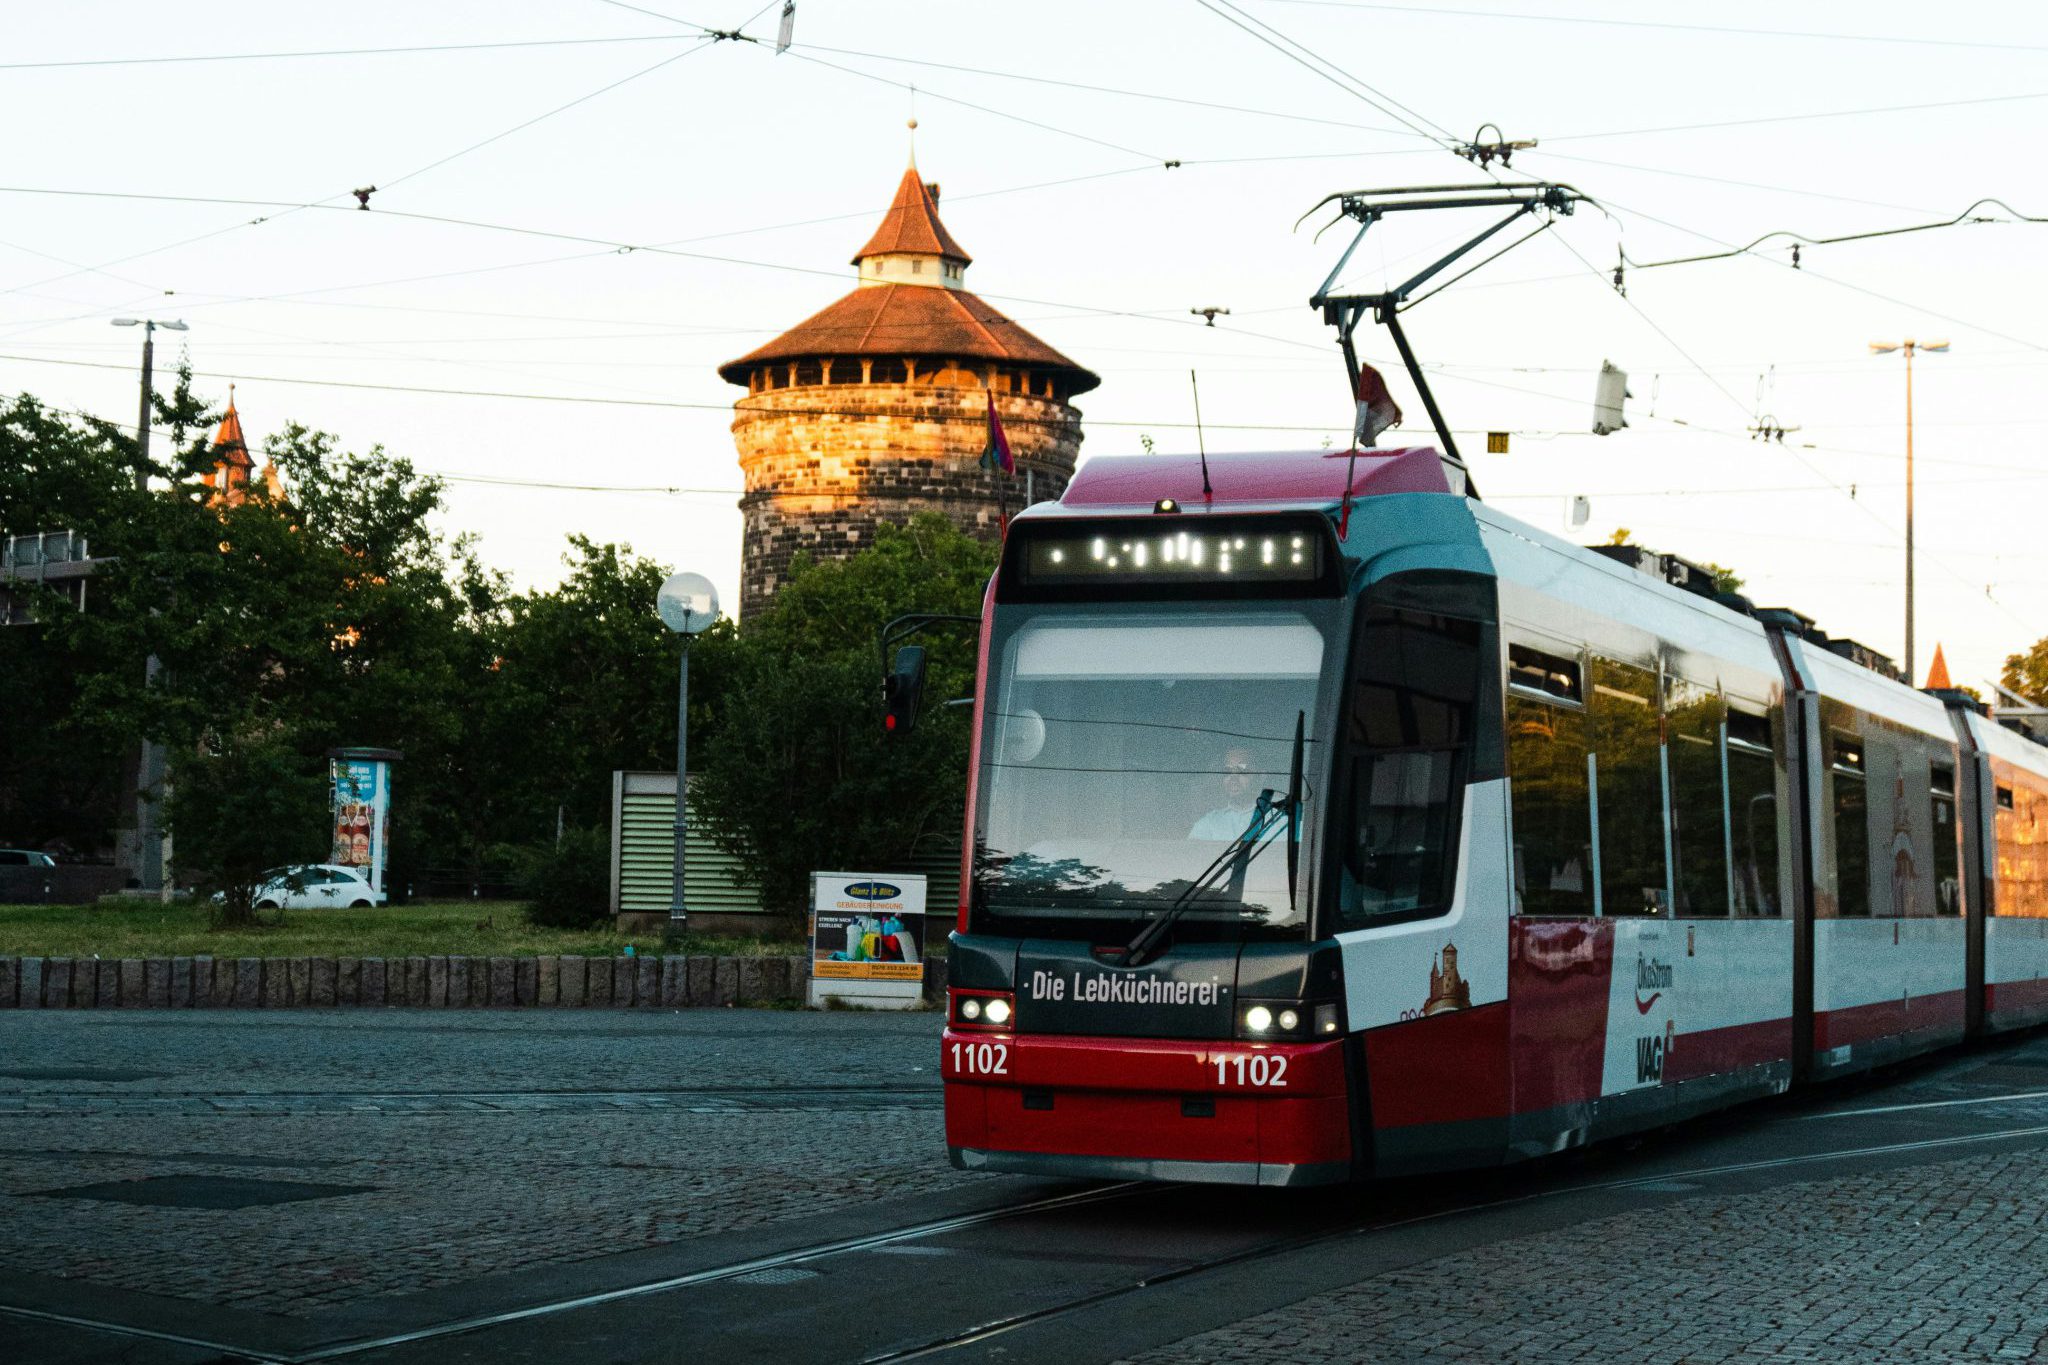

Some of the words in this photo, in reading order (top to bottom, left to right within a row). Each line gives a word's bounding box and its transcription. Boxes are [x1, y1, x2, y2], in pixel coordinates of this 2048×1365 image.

[1032, 971, 1065, 1001] Die
[1073, 972, 1218, 1005] Lebküchnerei
[951, 1043, 1008, 1074] 1102
[1213, 1054, 1288, 1087] 1102
[1637, 1035, 1663, 1083] VAG
